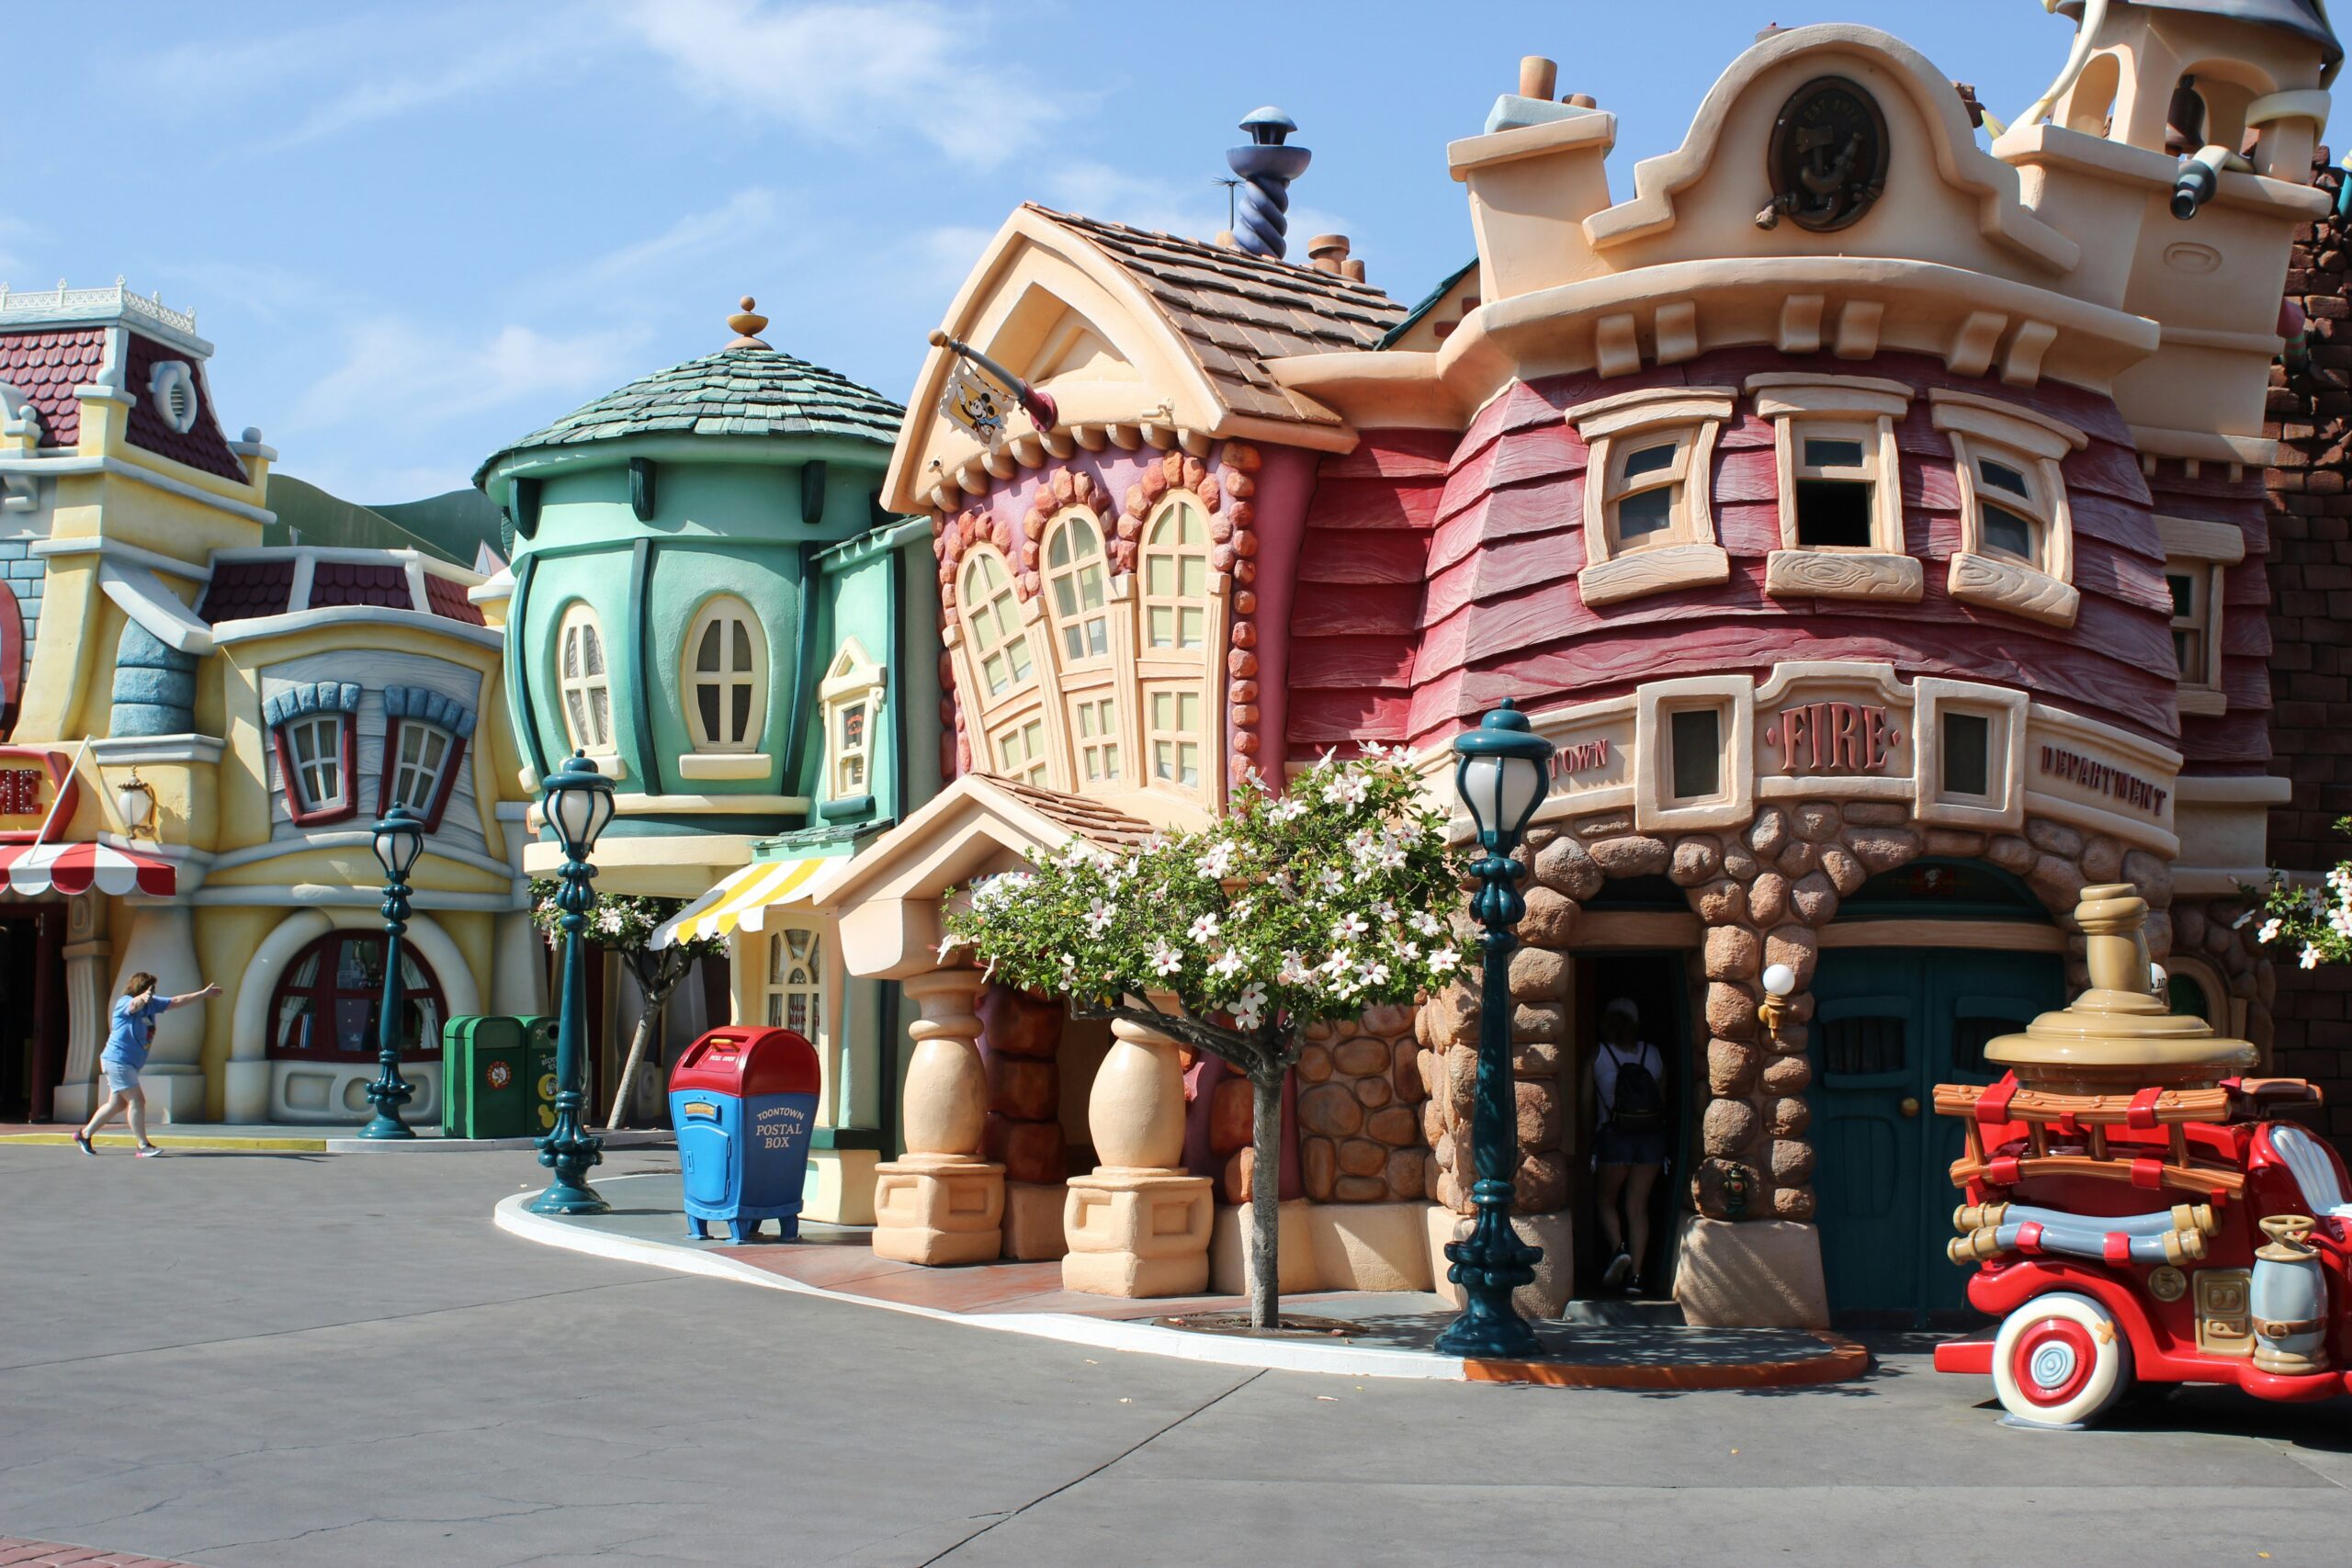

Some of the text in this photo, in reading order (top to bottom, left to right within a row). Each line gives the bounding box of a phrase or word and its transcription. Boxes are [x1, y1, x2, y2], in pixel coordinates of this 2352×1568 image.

[1780, 702, 1888, 771] FIRE
[2041, 745, 2167, 817] DEPARTMENT
[757, 1107, 805, 1121] TOONTOWN
[755, 1123, 803, 1136] POSTAL
[764, 1137, 790, 1149] BOX
[2157, 1272, 2177, 1294] 5
